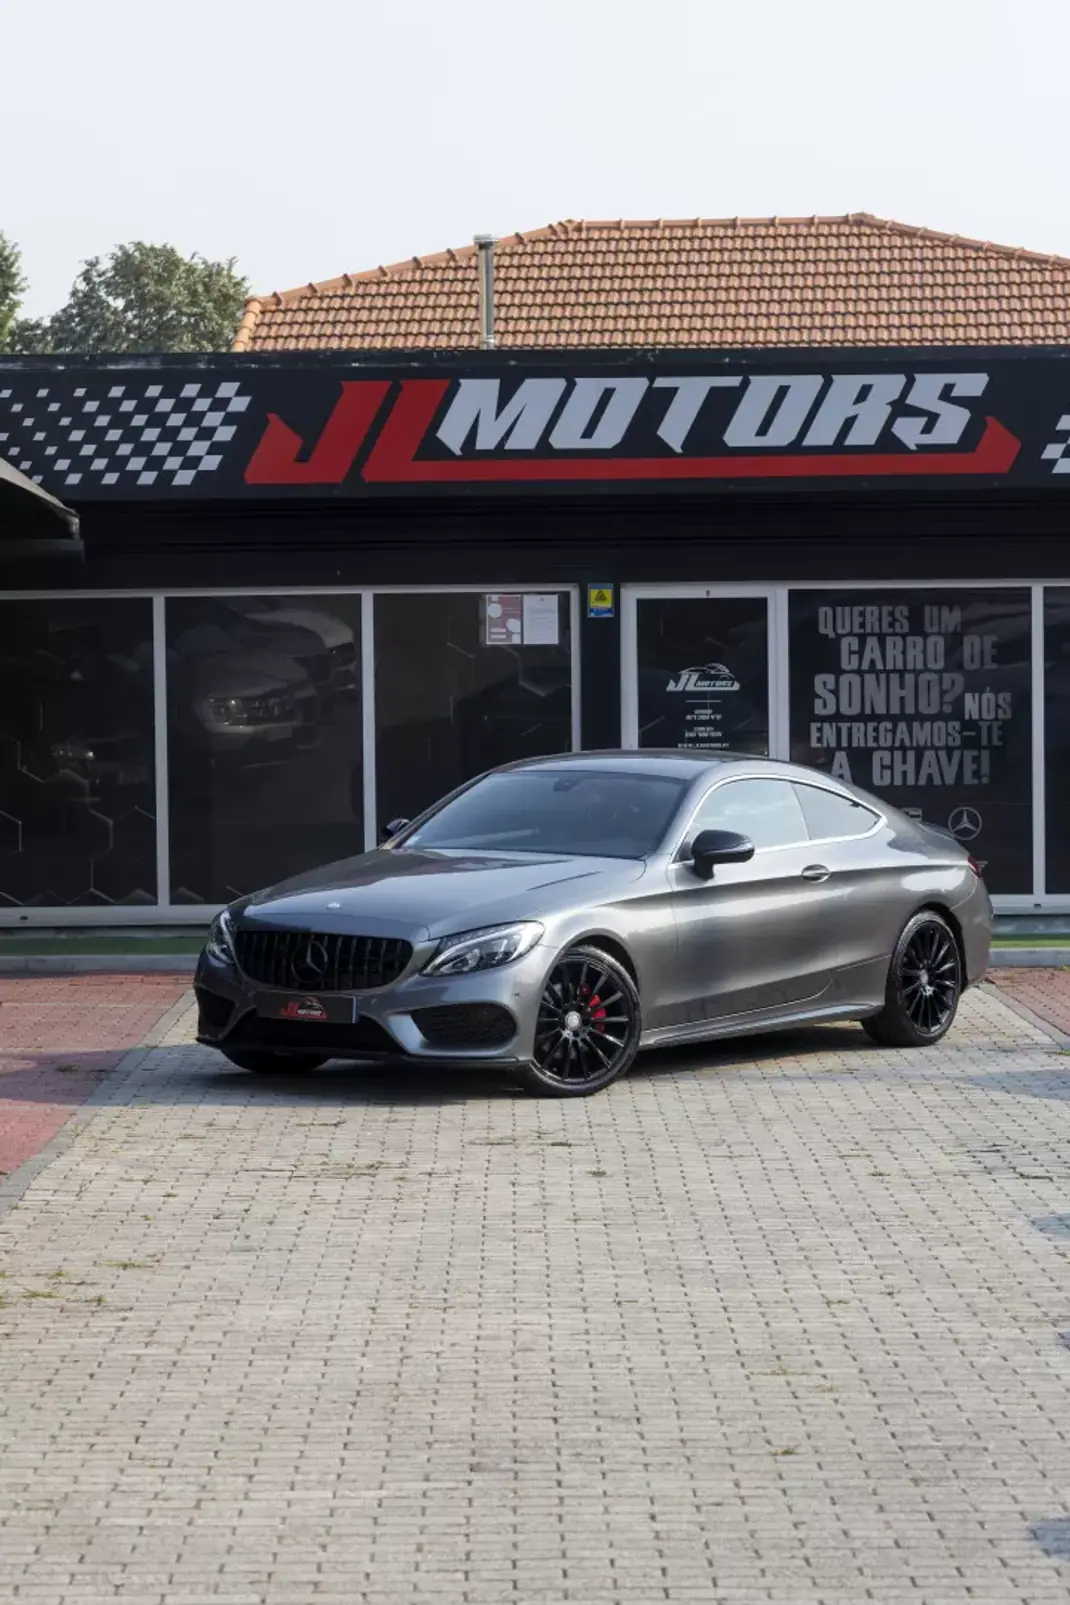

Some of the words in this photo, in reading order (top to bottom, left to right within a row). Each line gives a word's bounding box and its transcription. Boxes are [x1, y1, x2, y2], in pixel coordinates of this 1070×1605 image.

[435, 372, 990, 456] MOTORS
[817, 605, 910, 639] QUERES
[923, 605, 963, 633] UM
[840, 635, 945, 671] CARRO
[813, 671, 966, 716] SONHO?
[964, 686, 1012, 721] NÓS
[809, 720, 1004, 748] ENTREGAMOS-TE
[831, 750, 854, 785] A
[872, 750, 991, 787] CHAVE!
